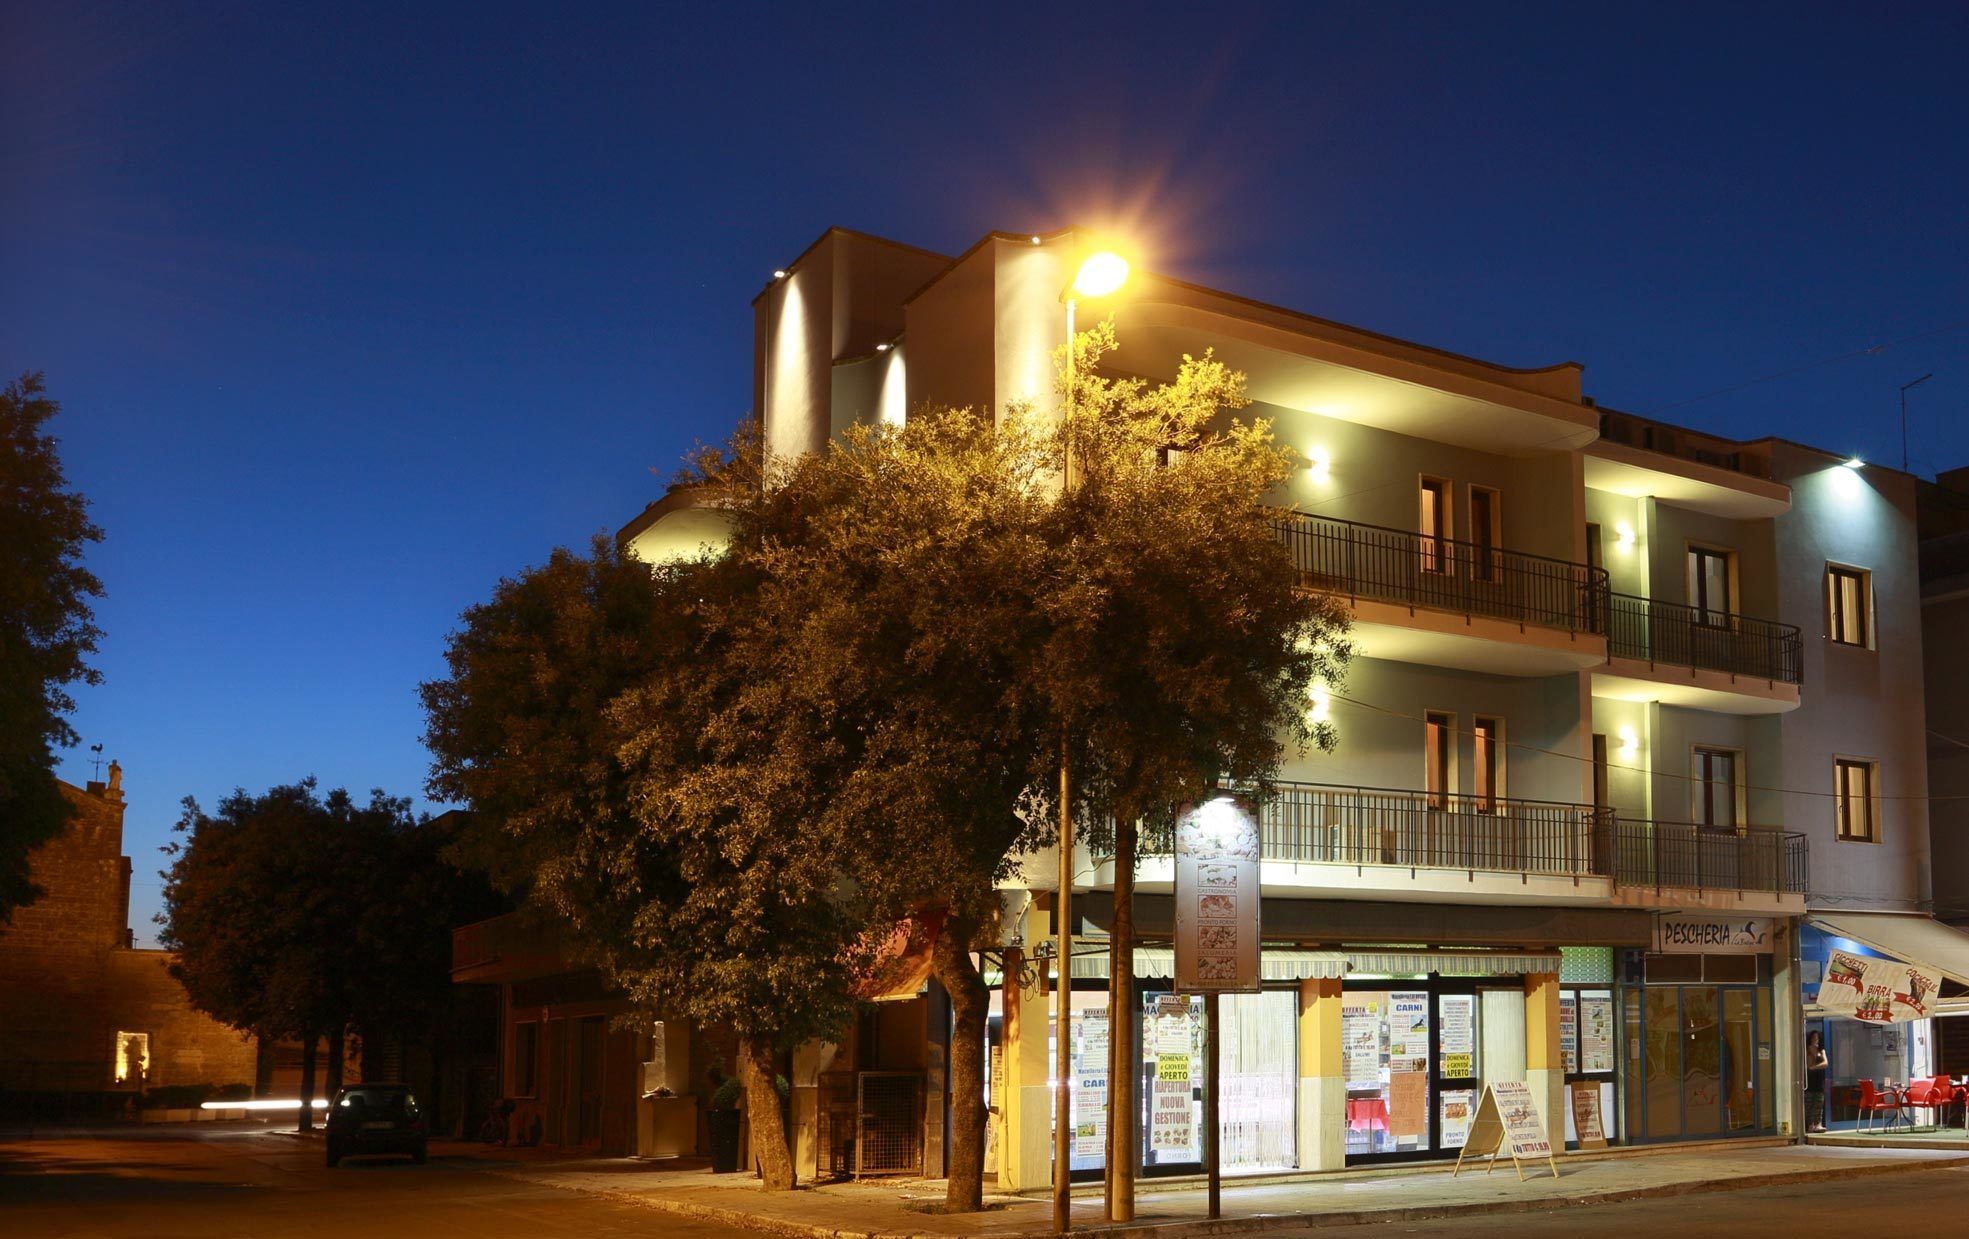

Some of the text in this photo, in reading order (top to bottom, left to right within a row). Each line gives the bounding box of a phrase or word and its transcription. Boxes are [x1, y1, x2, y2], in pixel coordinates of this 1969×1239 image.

[1665, 922, 1730, 946] PESCHERIA
[1905, 968, 1938, 993] COCKTAIL
[1867, 985, 1892, 998] BIRRA
[1155, 1081, 1190, 1092] RIAPERTURA
[1160, 1096, 1184, 1108] NUOVA
[1155, 1112, 1190, 1124] GESTIONE
